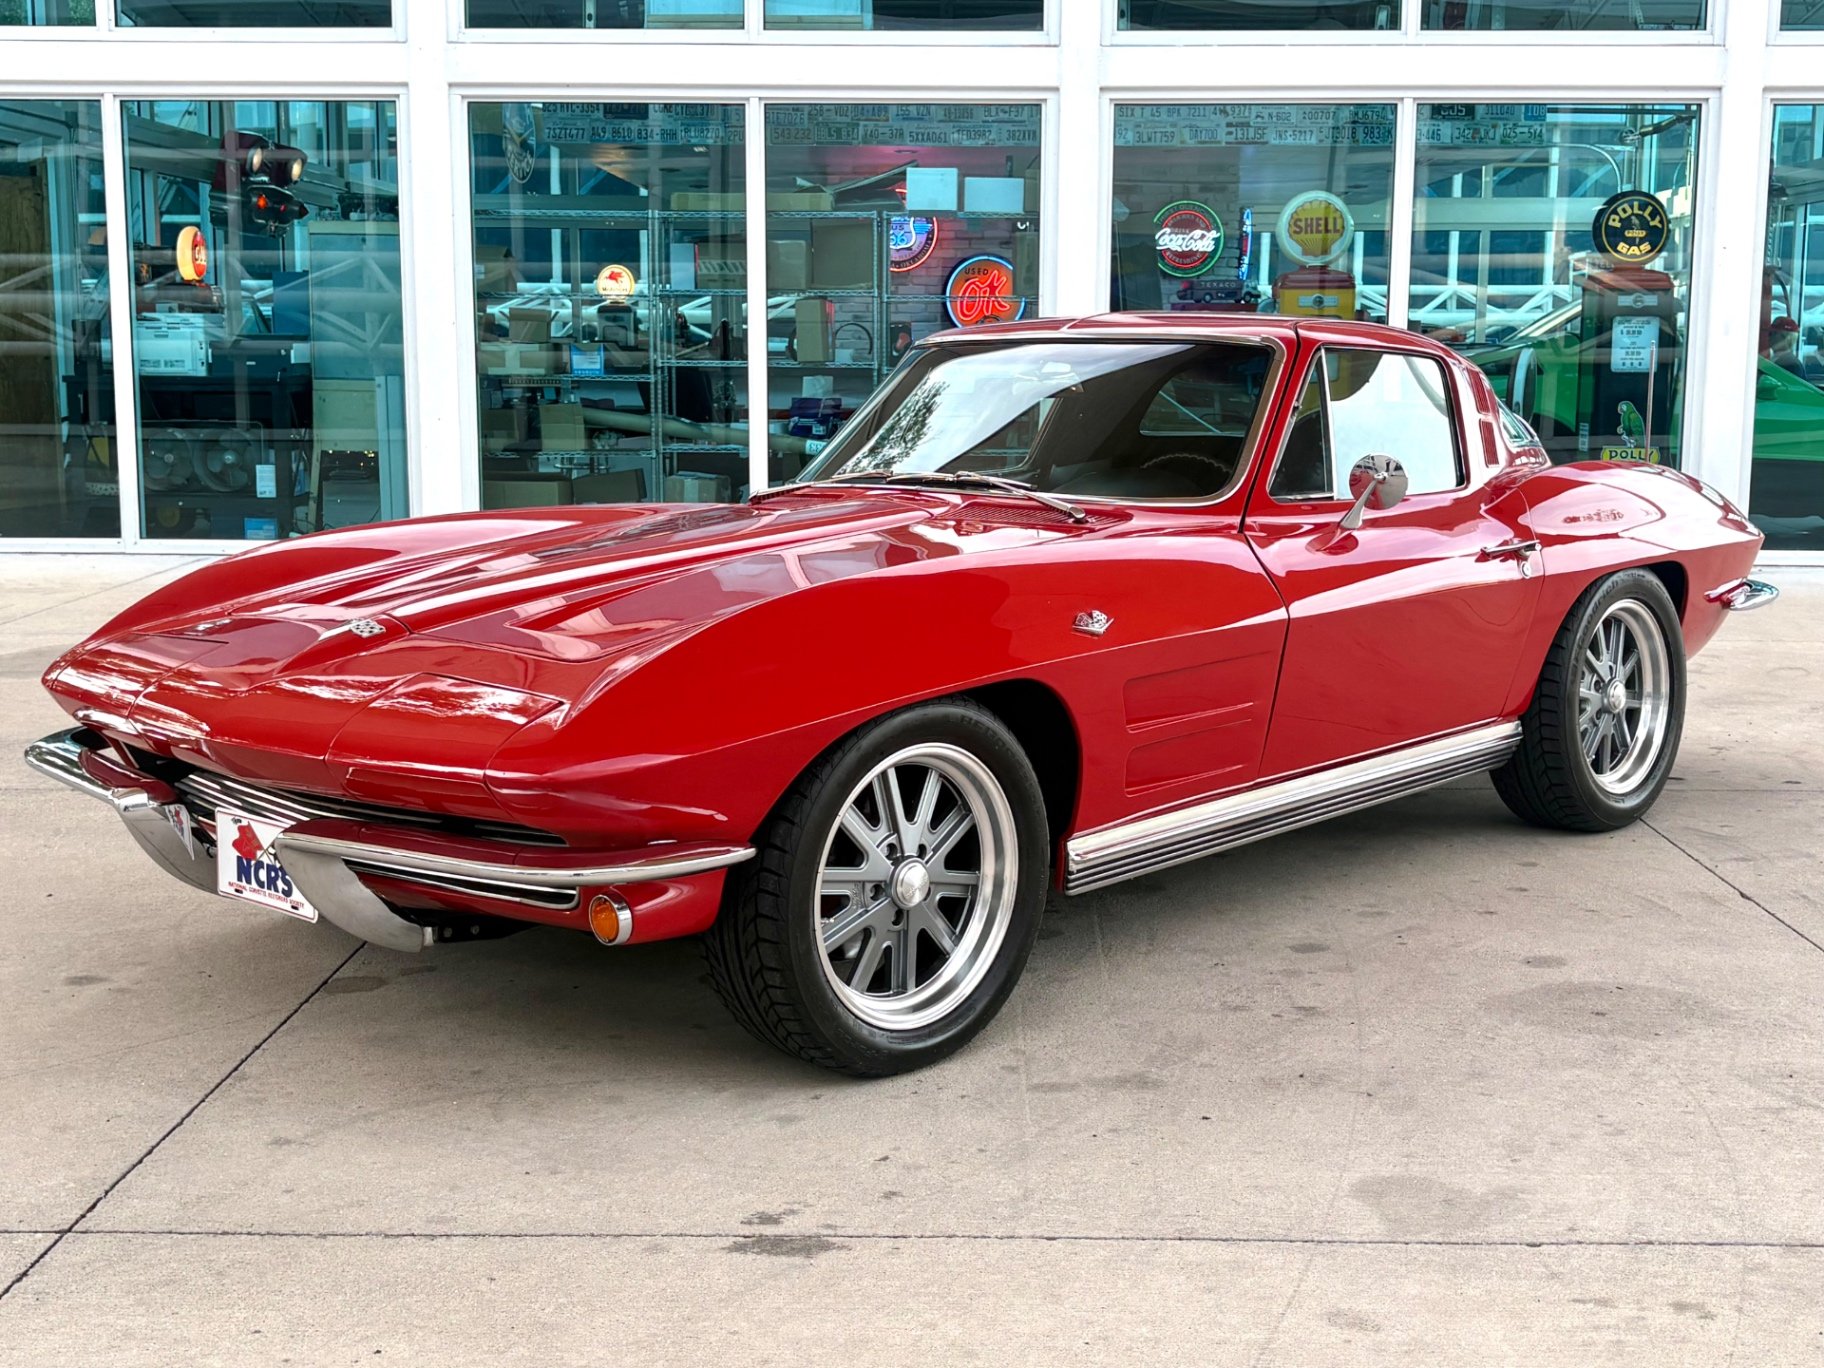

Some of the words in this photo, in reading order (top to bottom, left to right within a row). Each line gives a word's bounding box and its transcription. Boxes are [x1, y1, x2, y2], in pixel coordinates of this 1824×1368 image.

[1608, 201, 1662, 228] POLLY
[1293, 217, 1340, 235] SHELL
[1616, 241, 1652, 256] GAS
[957, 270, 1011, 320] OK
[228, 881, 248, 892] NATIONAL
[236, 855, 294, 898] NCRS
